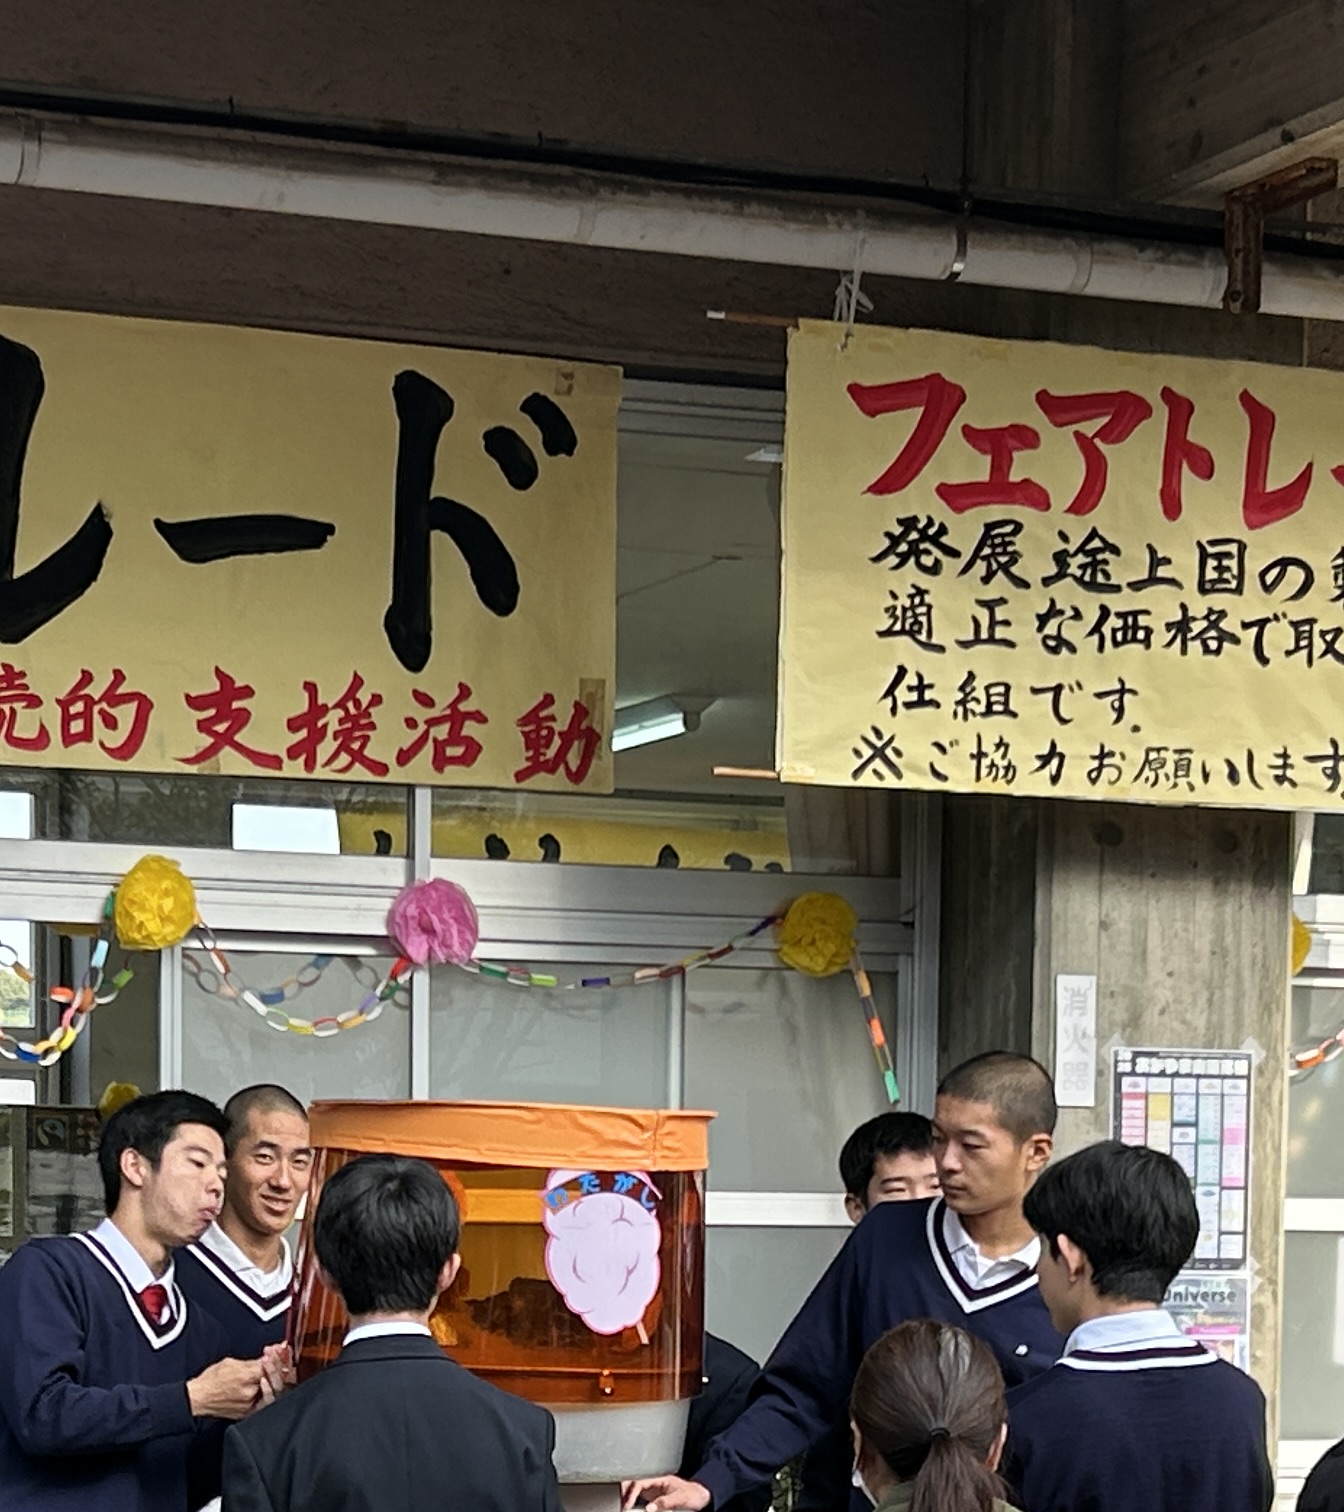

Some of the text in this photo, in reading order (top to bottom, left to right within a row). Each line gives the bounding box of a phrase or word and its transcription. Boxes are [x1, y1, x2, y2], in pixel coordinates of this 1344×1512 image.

[877, 664, 1142, 736] 仕組です。
[1062, 981, 1092, 1092] 消火器
[544, 1170, 657, 1212] わたがし
